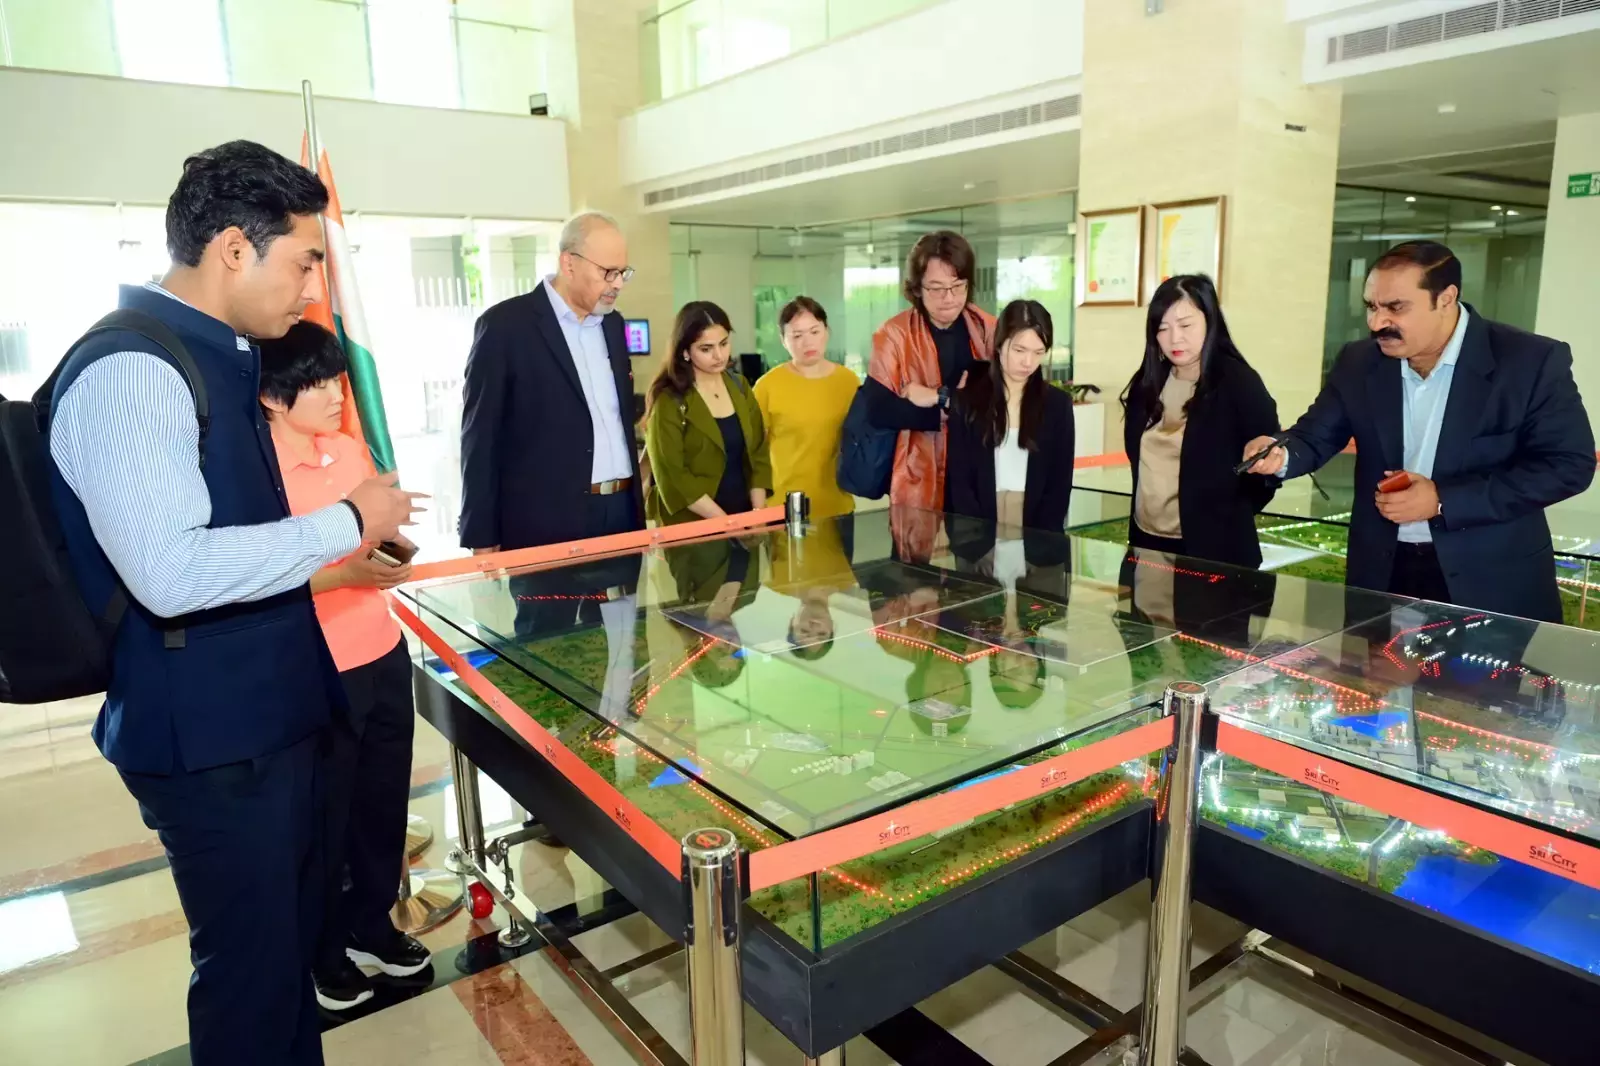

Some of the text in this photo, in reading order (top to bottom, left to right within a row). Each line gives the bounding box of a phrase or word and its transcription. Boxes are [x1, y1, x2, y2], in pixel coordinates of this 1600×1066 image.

[1321, 774, 1340, 786] CITY
[1529, 845, 1546, 859] SRI
[1552, 853, 1578, 868] CITY
